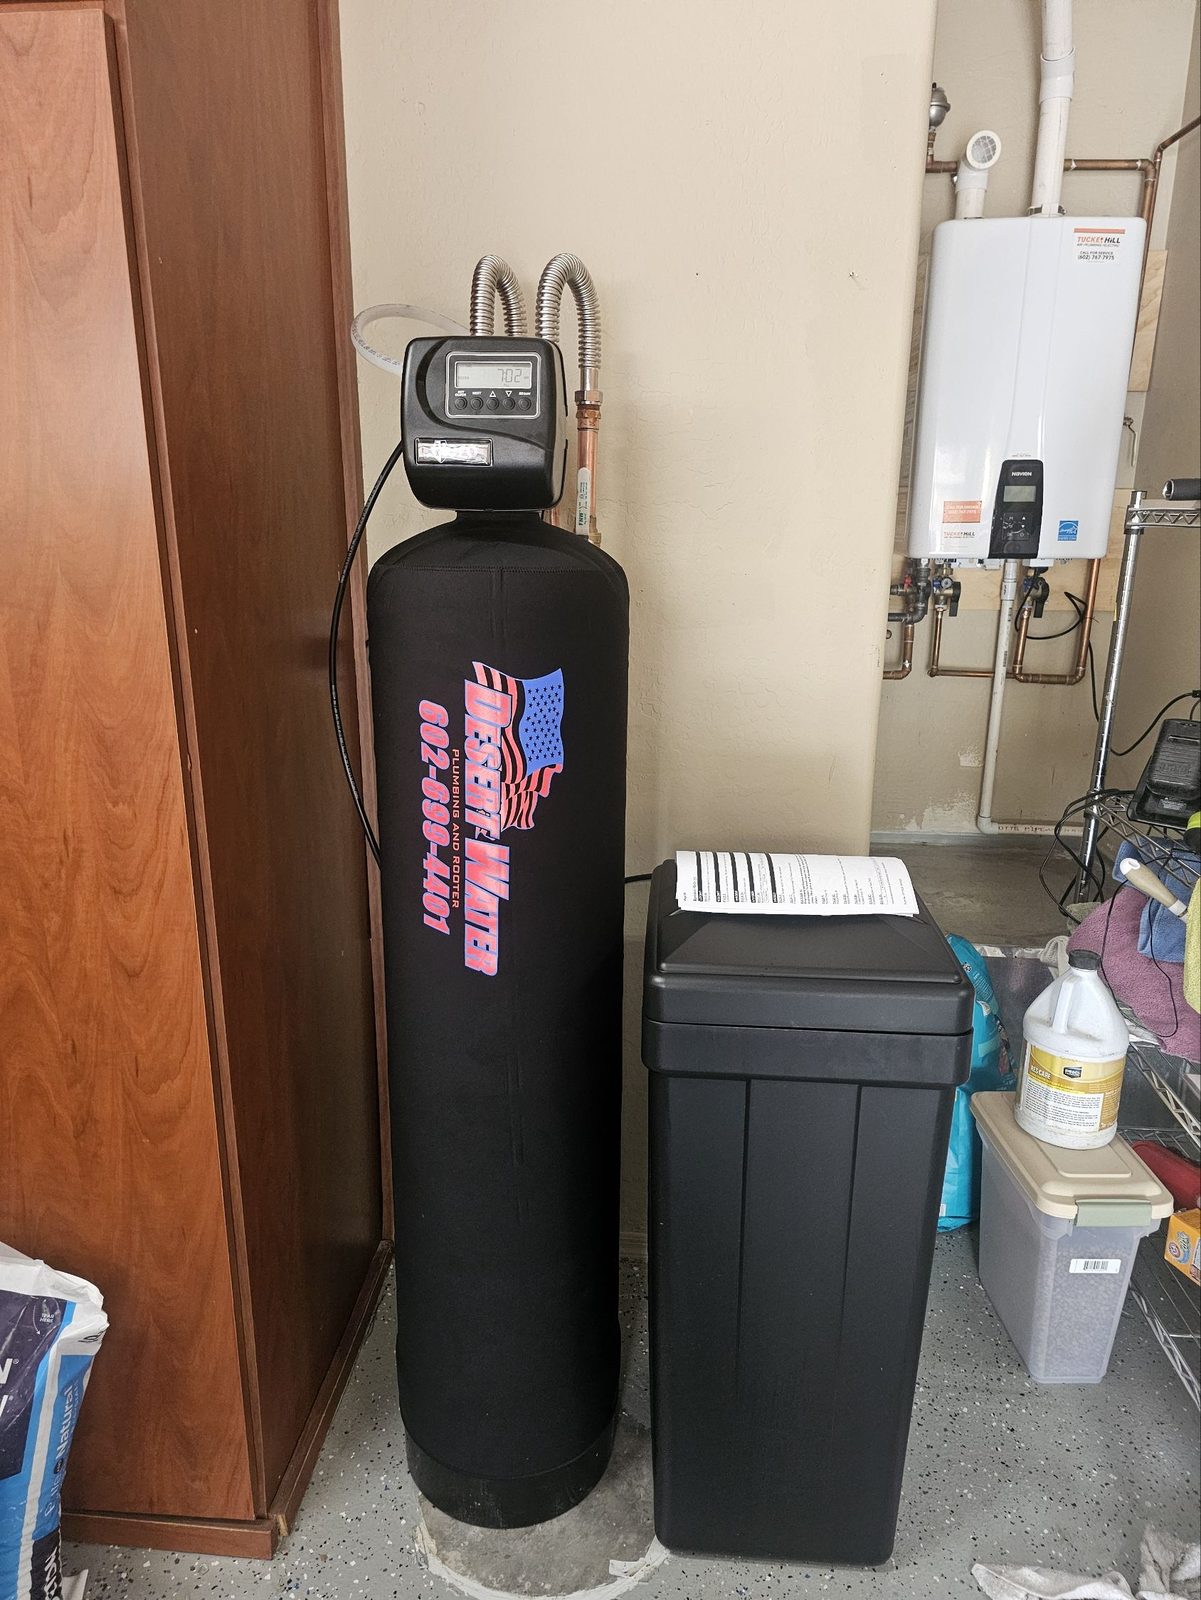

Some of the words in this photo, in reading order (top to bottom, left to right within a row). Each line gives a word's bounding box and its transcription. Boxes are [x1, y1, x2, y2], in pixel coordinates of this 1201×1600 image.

[451, 748, 460, 819] PLUMBING
[464, 679, 512, 840] DESERT
[419, 699, 450, 935] 602-699-4401
[451, 822, 460, 852] AND
[451, 855, 460, 909] ROOTER
[464, 837, 510, 977] WATER
[56, 1385, 73, 1460] Natural
